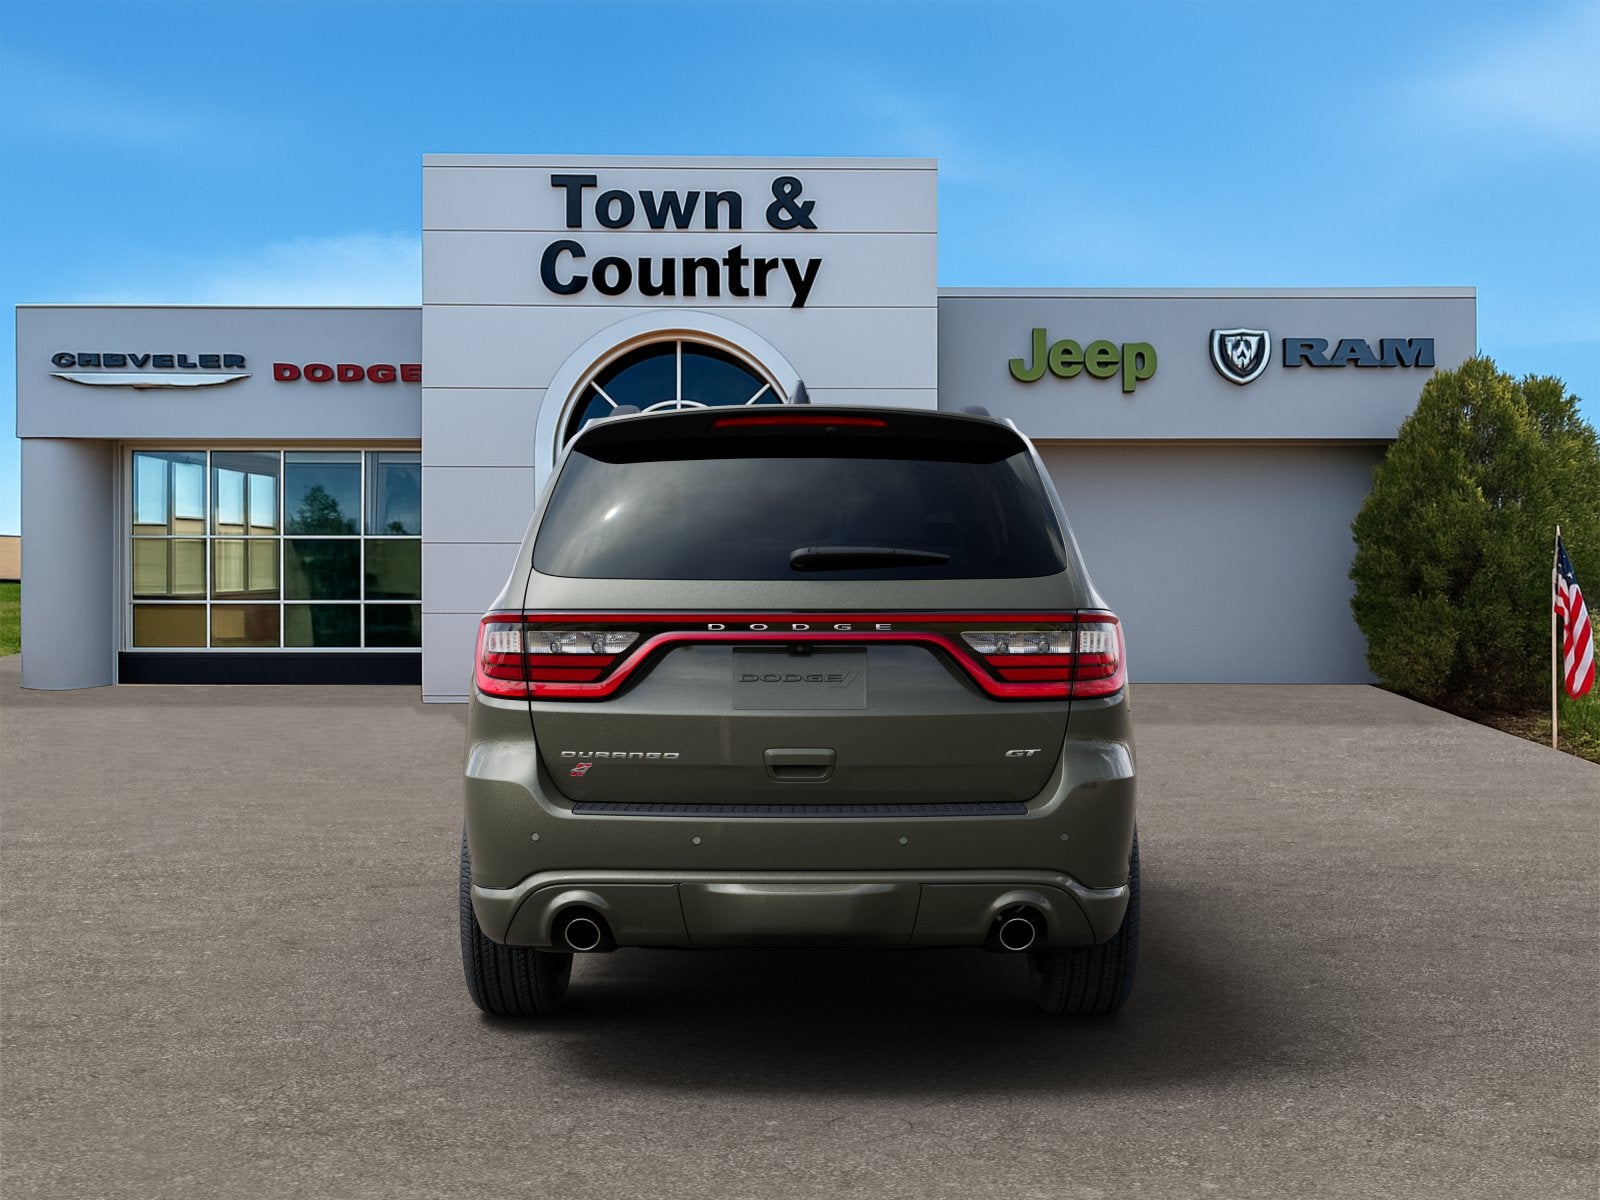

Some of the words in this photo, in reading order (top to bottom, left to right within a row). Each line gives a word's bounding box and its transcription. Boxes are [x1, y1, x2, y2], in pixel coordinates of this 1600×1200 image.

[551, 174, 742, 229] Town
[766, 176, 818, 229] &
[540, 239, 822, 308] Country
[1009, 328, 1158, 393] Jeep
[1282, 337, 1436, 368] RAM
[273, 363, 422, 383] DODGE
[707, 623, 892, 631] DODGE
[739, 674, 843, 682] DODGE
[560, 751, 680, 759] DURANGO
[1005, 748, 1042, 757] GT
